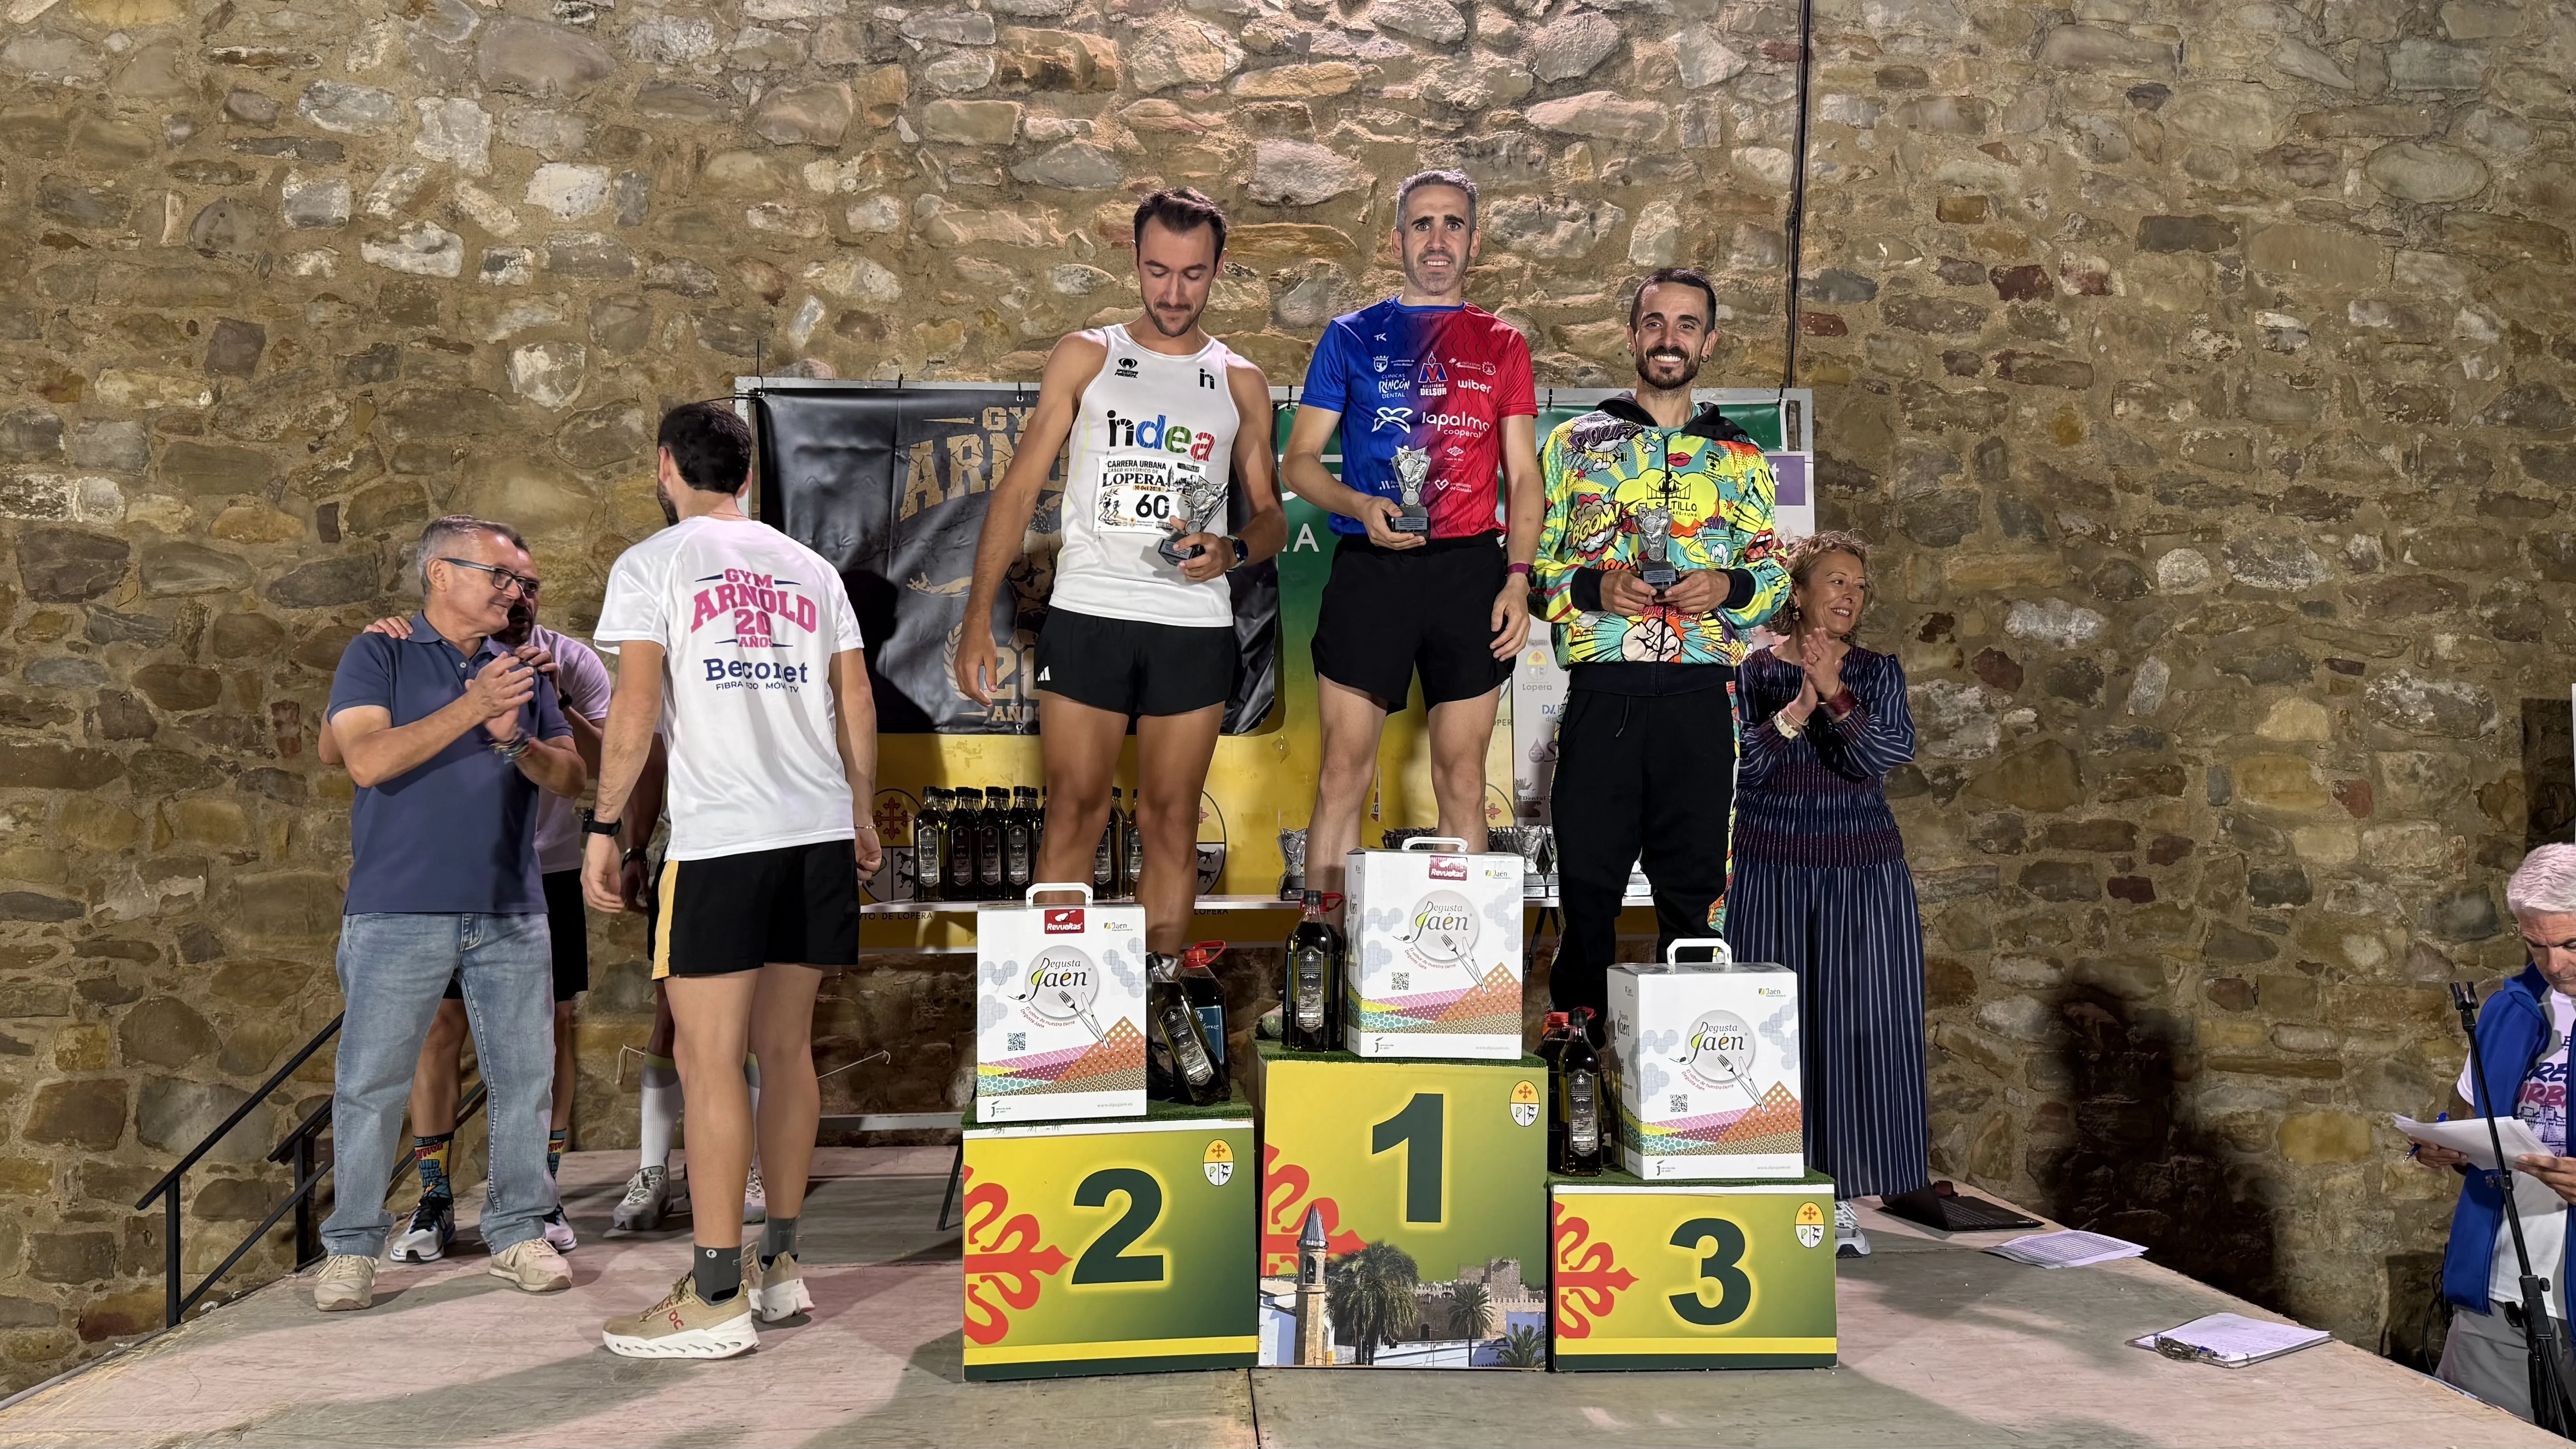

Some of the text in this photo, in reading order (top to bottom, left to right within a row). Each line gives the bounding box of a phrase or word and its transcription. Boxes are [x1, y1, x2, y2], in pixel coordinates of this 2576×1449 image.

[1200, 368, 1215, 389] in
[1457, 379, 1492, 394] wiber
[1420, 387, 1447, 396] DELSUR
[982, 407, 1036, 431] GY
[1107, 409, 1215, 462] indea
[1107, 460, 1166, 470] CARRERA URBANA
[900, 433, 1069, 523] ARN
[1102, 473, 1167, 488] LOPERA
[1136, 494, 1170, 519] 60
[1656, 501, 1697, 512] STILLO
[1571, 503, 1624, 545] BOOM!
[725, 568, 773, 589] GYM
[690, 584, 816, 634] ARNOLD
[734, 609, 772, 636] 20
[716, 681, 744, 690] FIBRA
[1523, 683, 1552, 691] Lopera
[1431, 869, 1466, 878] Revueltas
[859, 912, 876, 920] YTO
[1423, 901, 1463, 913] Degusta
[1047, 922, 1082, 931] Revueltas
[1403, 913, 1468, 944] Jaén
[1039, 957, 1081, 970] Degusta
[1020, 969, 1088, 1003] Jaén
[1698, 1021, 1737, 1034] Degusta
[1680, 1033, 1744, 1065] Jaén
[1373, 1092, 1444, 1223] 1
[1072, 1168, 1164, 1285] 2
[1670, 1217, 1751, 1326] 3
